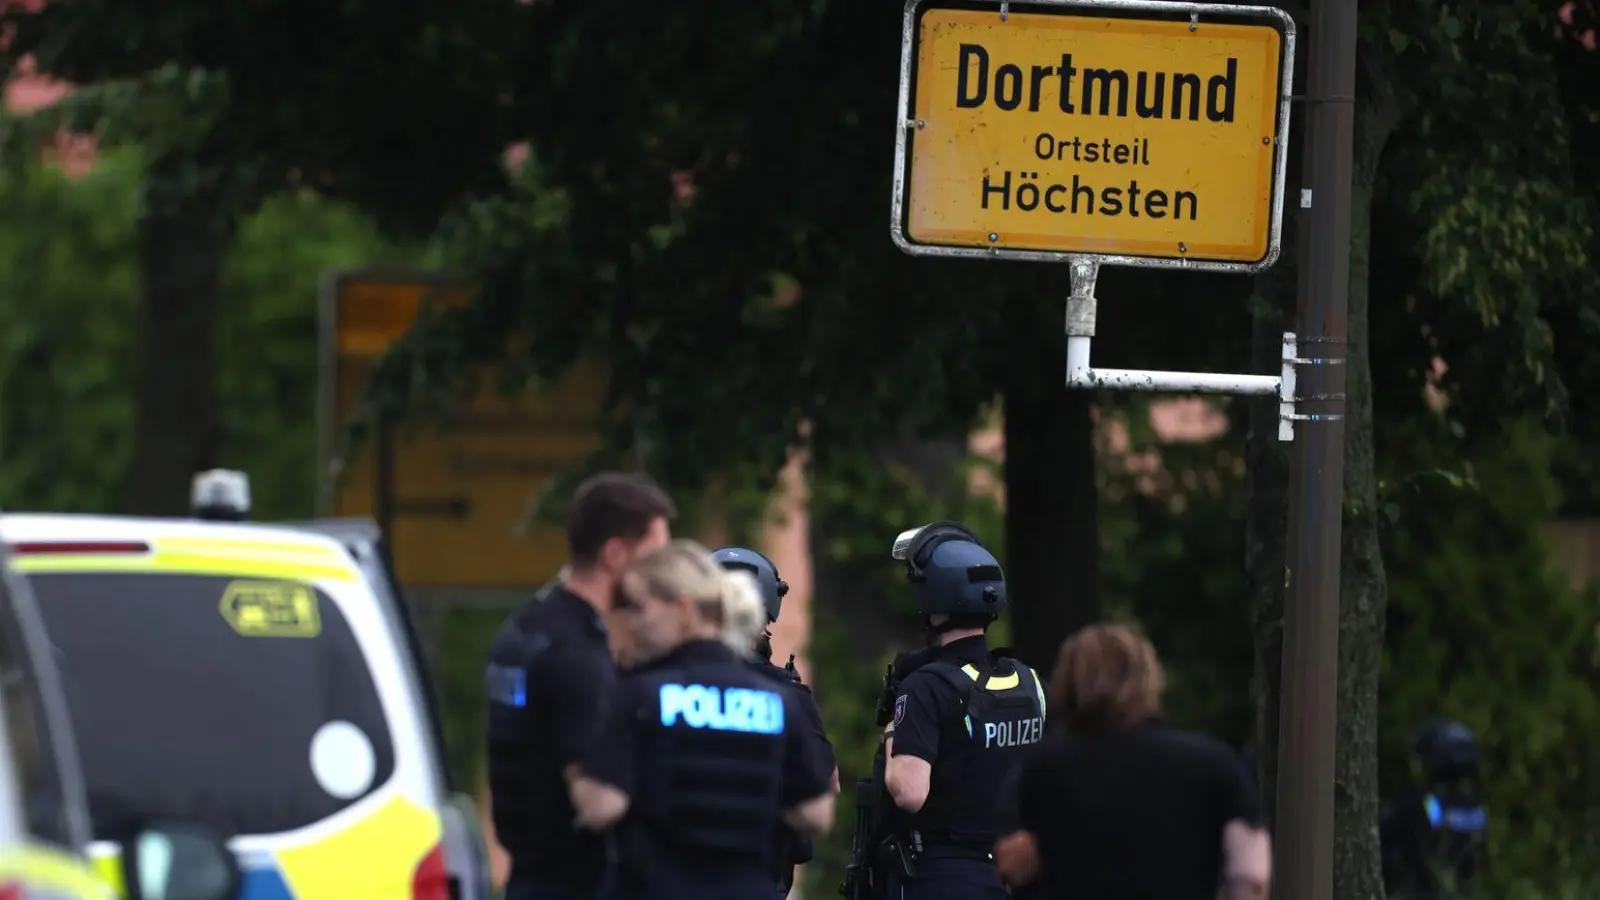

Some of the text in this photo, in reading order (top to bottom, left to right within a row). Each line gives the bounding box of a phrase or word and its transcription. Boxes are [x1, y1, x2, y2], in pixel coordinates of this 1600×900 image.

[956, 43, 1237, 122] Dortmund
[1035, 133, 1149, 165] Ortsteil
[981, 171, 1198, 220] Höchsten
[659, 683, 784, 735] POLIZEI
